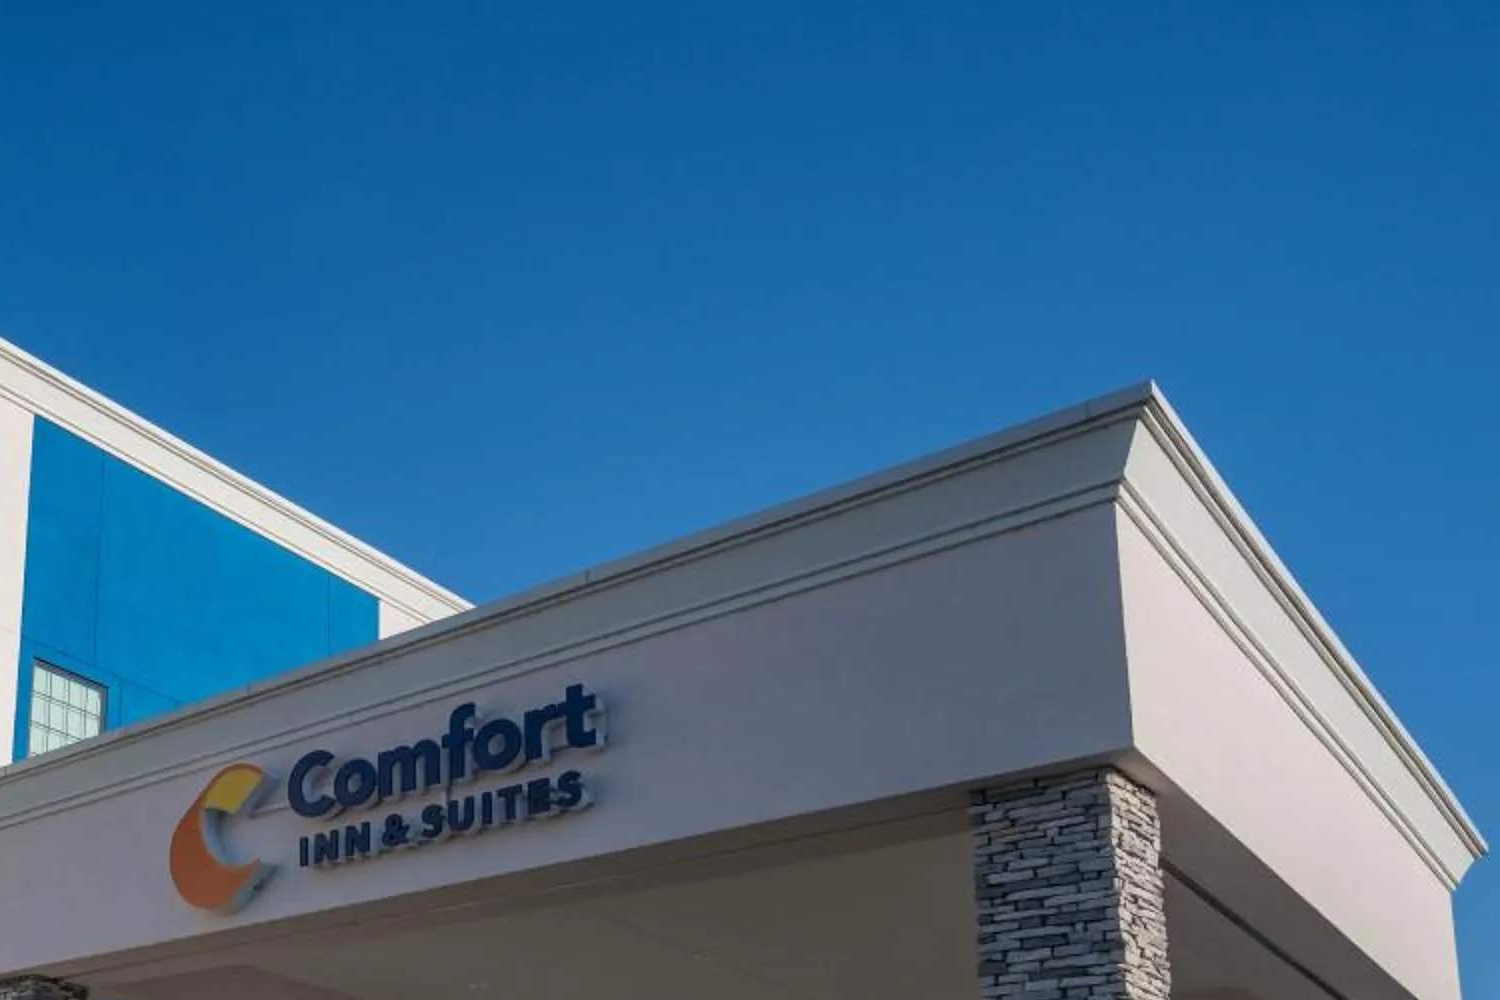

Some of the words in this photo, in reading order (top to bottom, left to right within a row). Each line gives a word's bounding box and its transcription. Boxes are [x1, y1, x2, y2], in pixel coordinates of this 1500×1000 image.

[287, 683, 598, 817] Comfort
[300, 822, 371, 866] INN
[382, 813, 411, 847] &
[421, 770, 583, 839] SUITES
